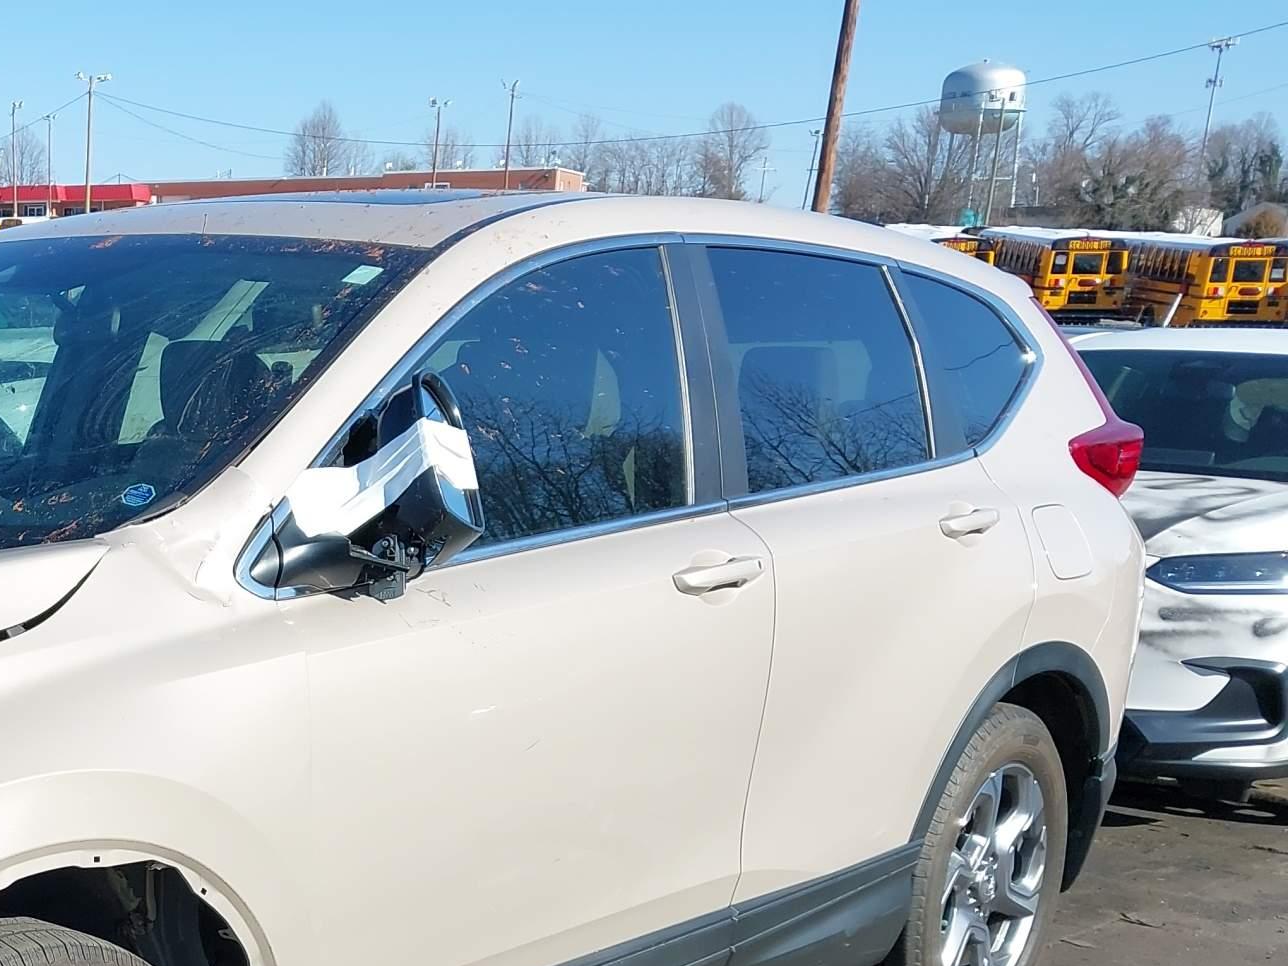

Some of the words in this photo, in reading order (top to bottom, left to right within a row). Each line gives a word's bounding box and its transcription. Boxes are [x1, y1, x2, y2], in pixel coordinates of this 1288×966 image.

[1071, 240, 1095, 250] SCHOOL
[1098, 240, 1112, 250] BUS
[1231, 247, 1257, 257] SCHOOL
[1260, 246, 1275, 257] BUS
